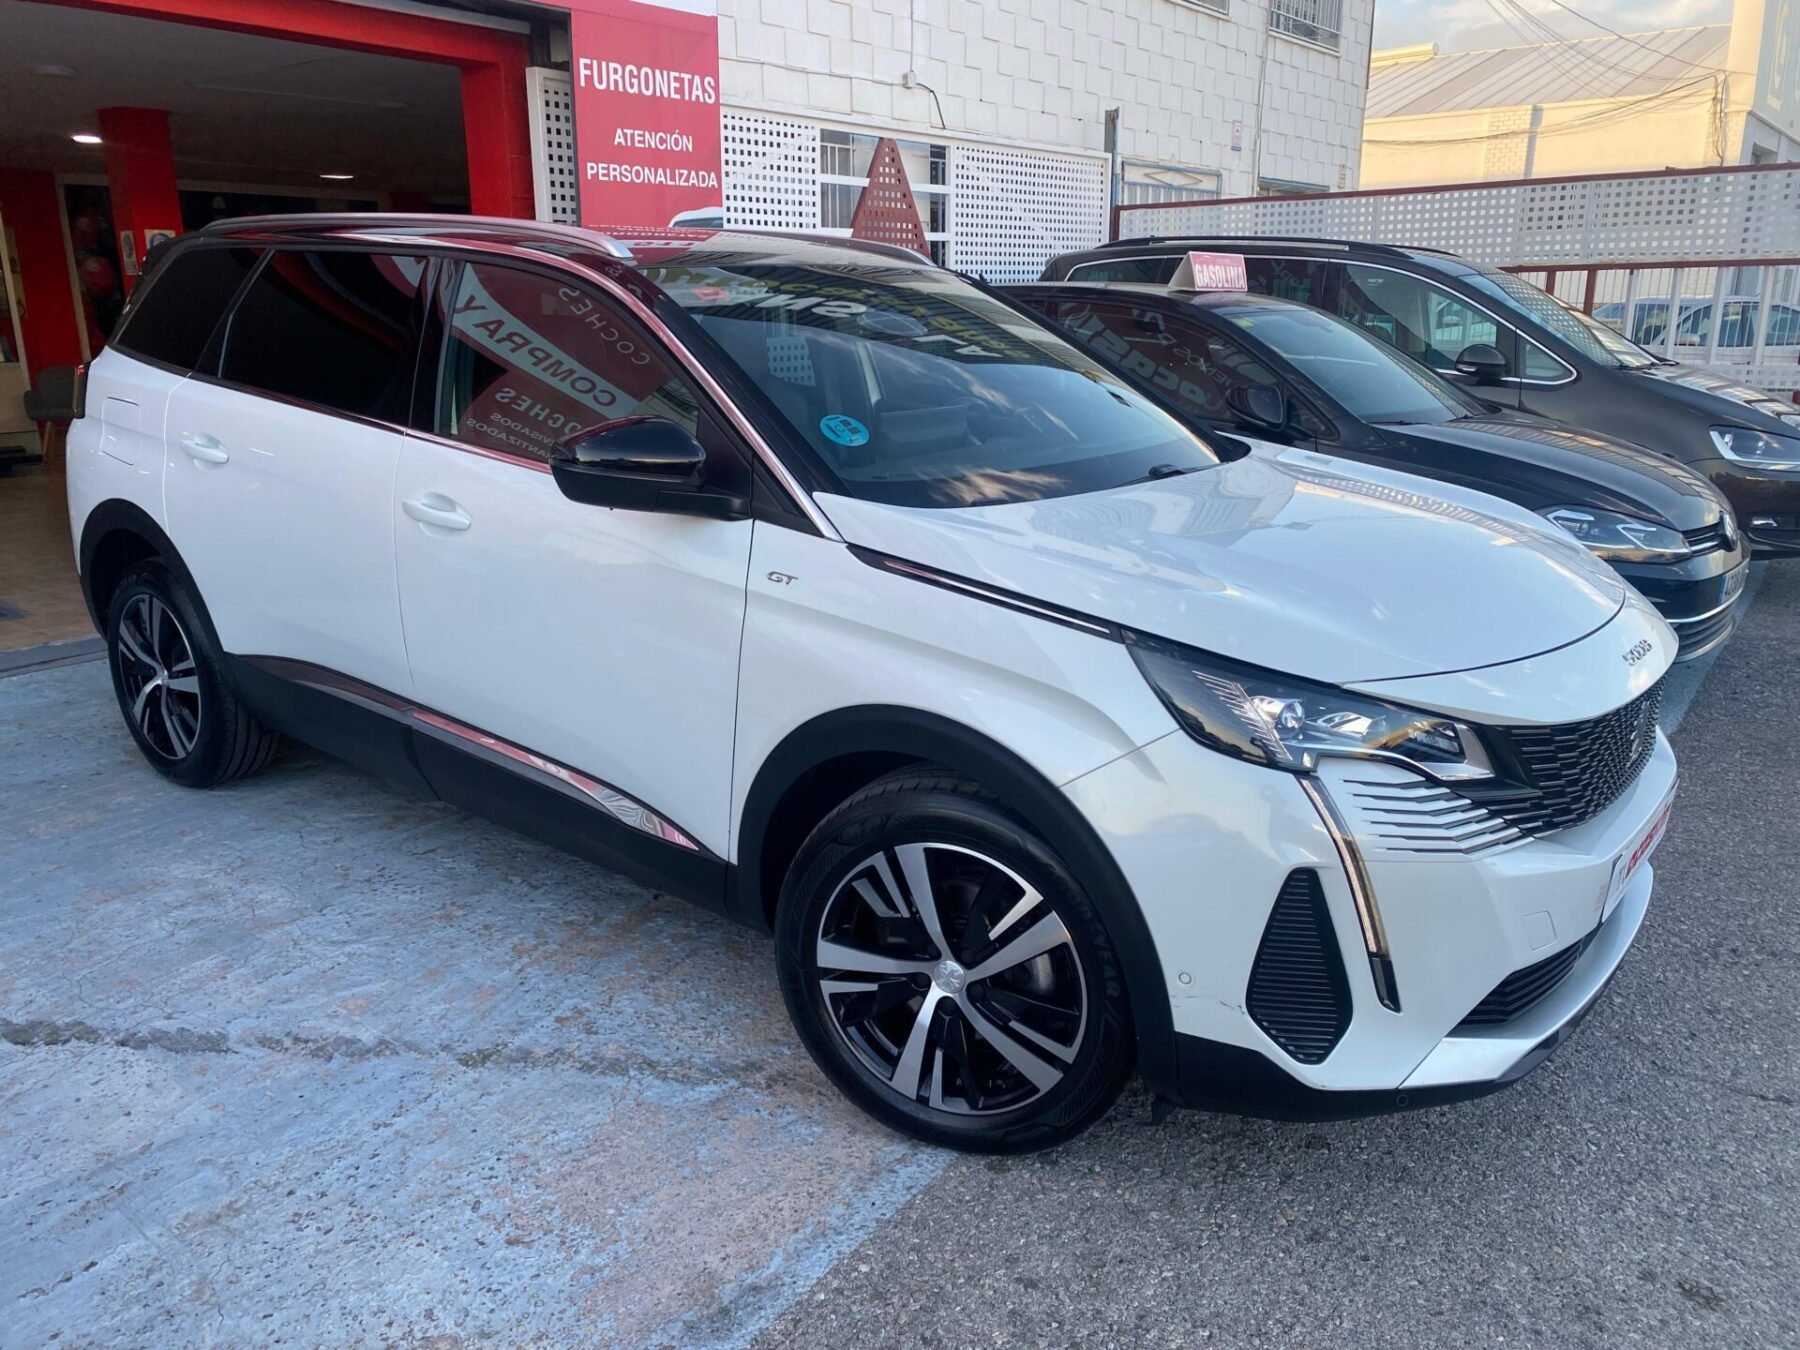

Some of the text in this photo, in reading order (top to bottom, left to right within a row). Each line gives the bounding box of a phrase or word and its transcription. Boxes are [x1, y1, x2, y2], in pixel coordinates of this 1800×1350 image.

[578, 57, 716, 104] FURGONETAS
[613, 128, 693, 152] ATENCIÓN
[586, 162, 719, 188] PERSONALIZADA
[1194, 264, 1246, 288] GASOLINA
[767, 571, 799, 585] GT
